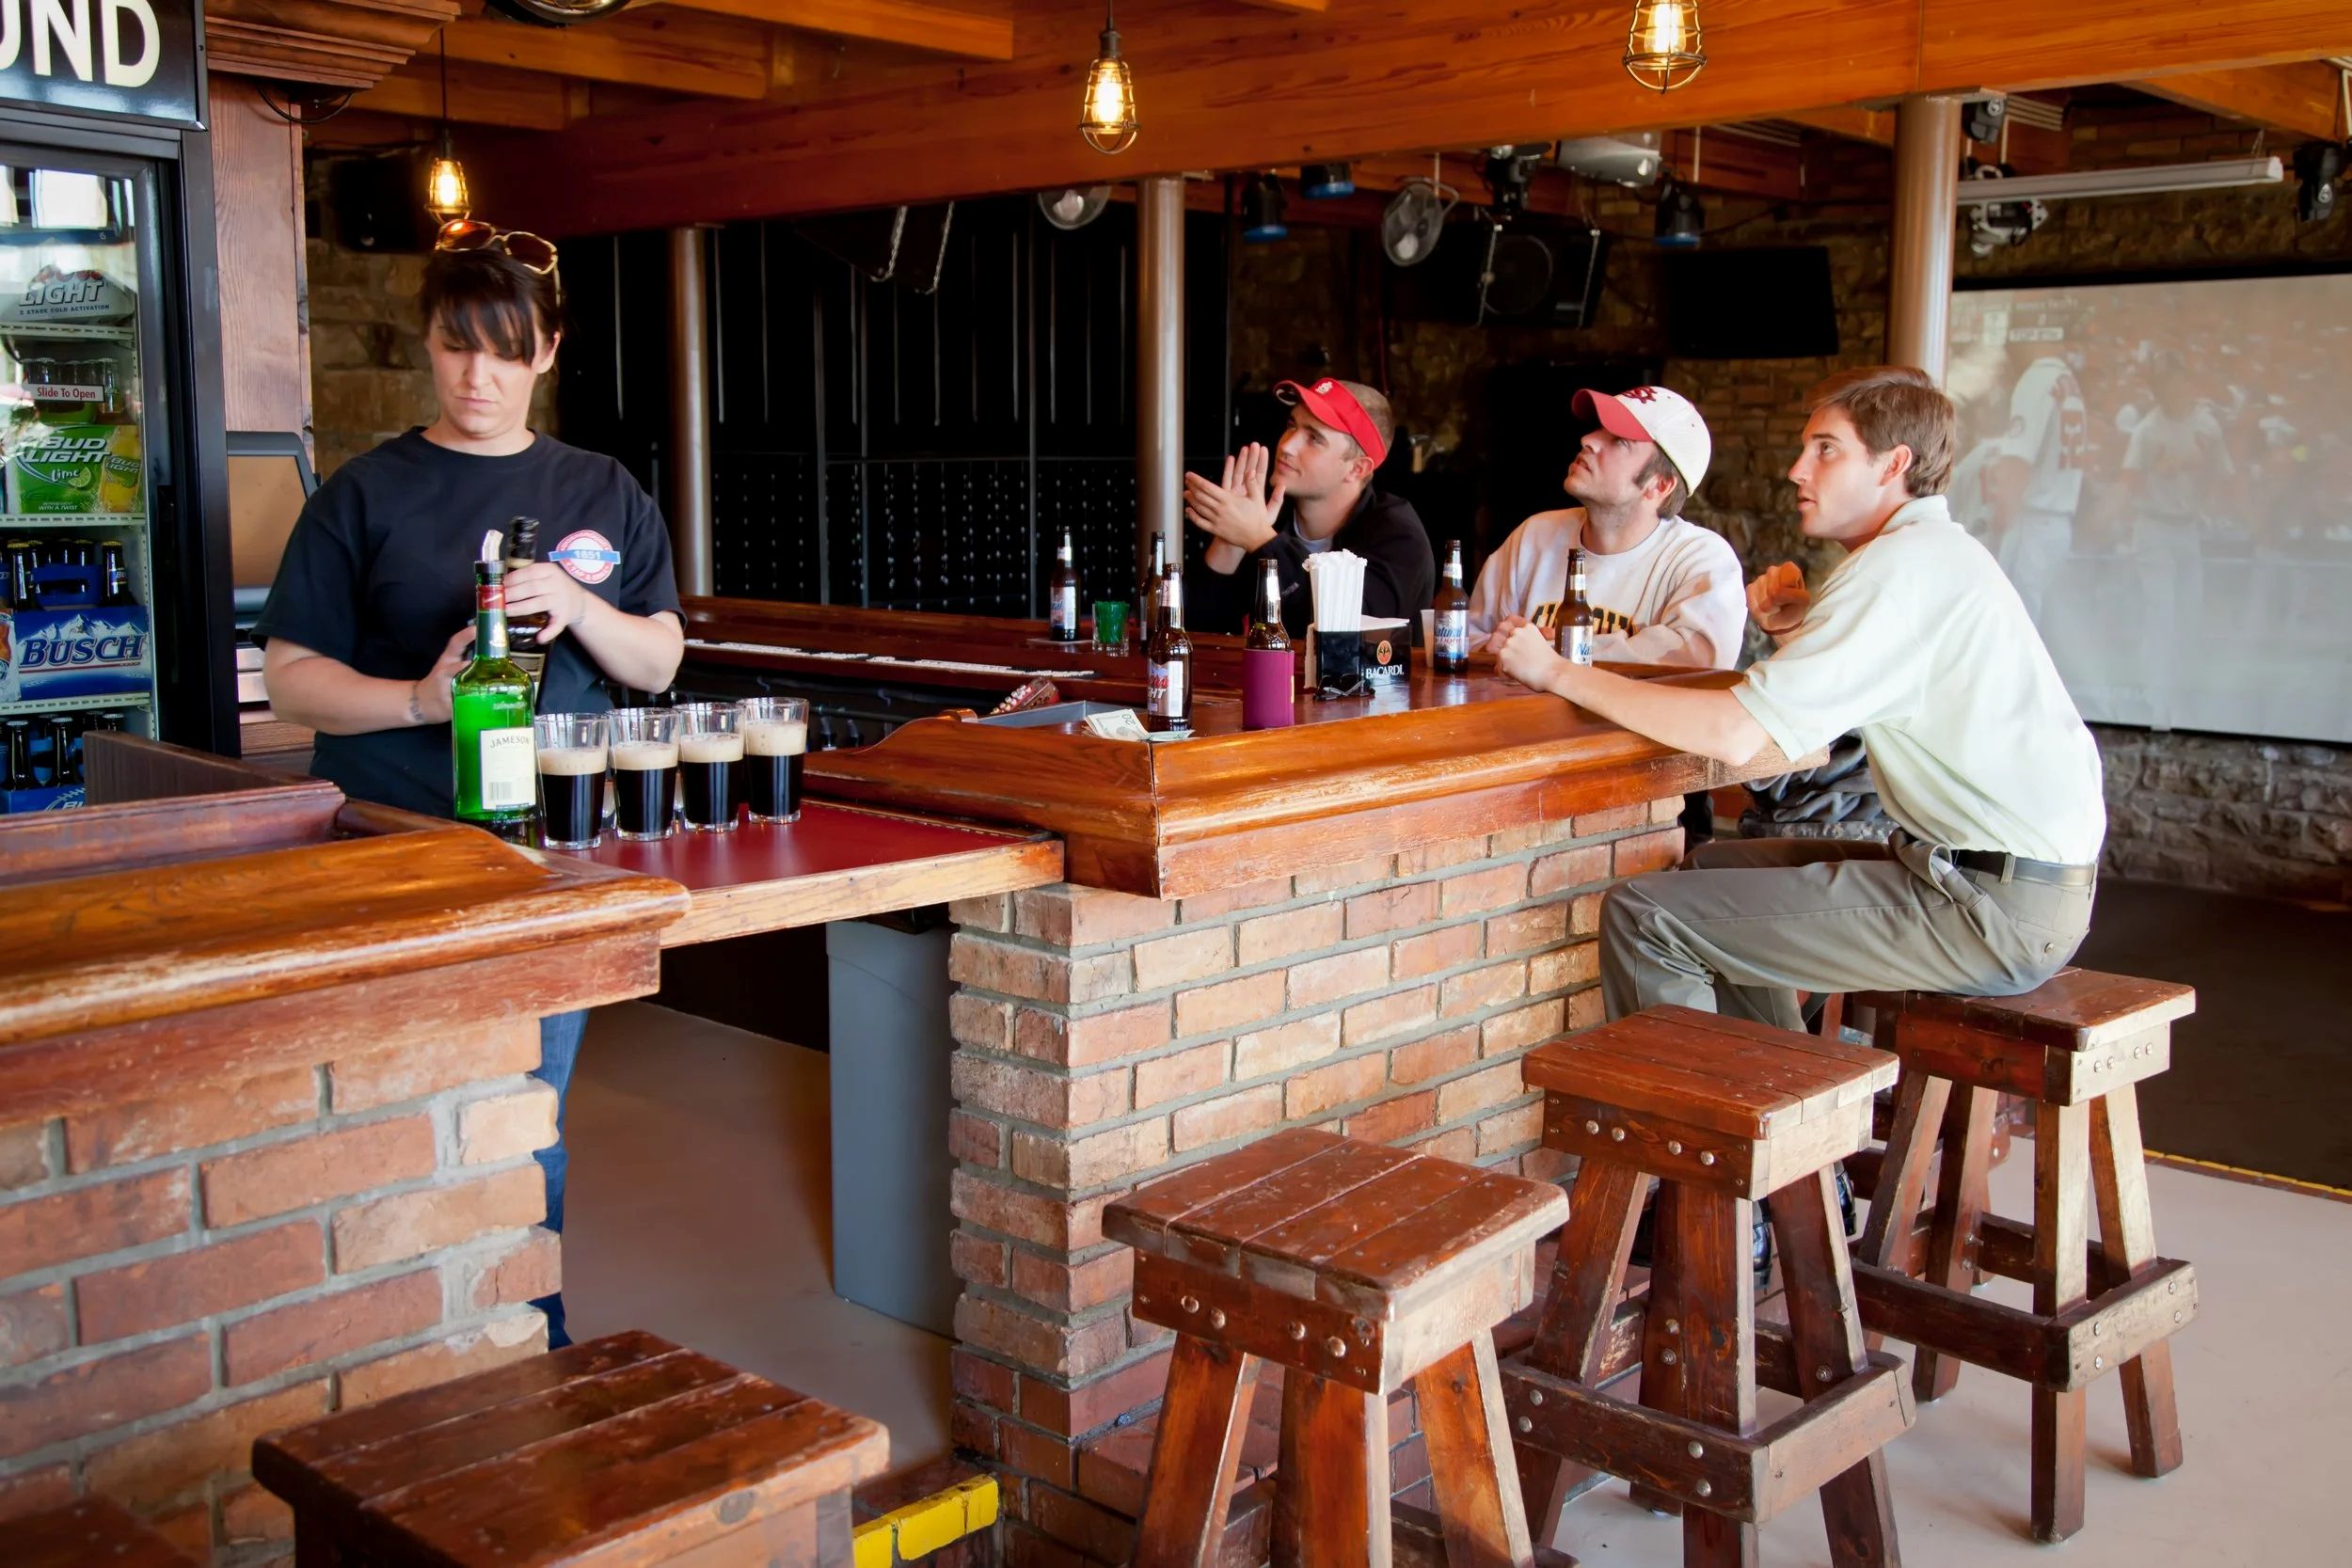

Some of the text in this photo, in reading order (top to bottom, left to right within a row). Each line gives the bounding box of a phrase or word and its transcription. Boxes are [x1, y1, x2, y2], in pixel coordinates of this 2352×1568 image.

[19, 280, 103, 307] LIGHT
[71, 304, 110, 312] ACTIVATION
[38, 387, 96, 400] Slide To Open
[40, 436, 106, 451] BUD
[24, 451, 112, 463] LIGHT
[20, 634, 144, 667] BUSCH
[1366, 664, 1402, 678] BACARDI
[490, 736, 531, 749] JAMESON
